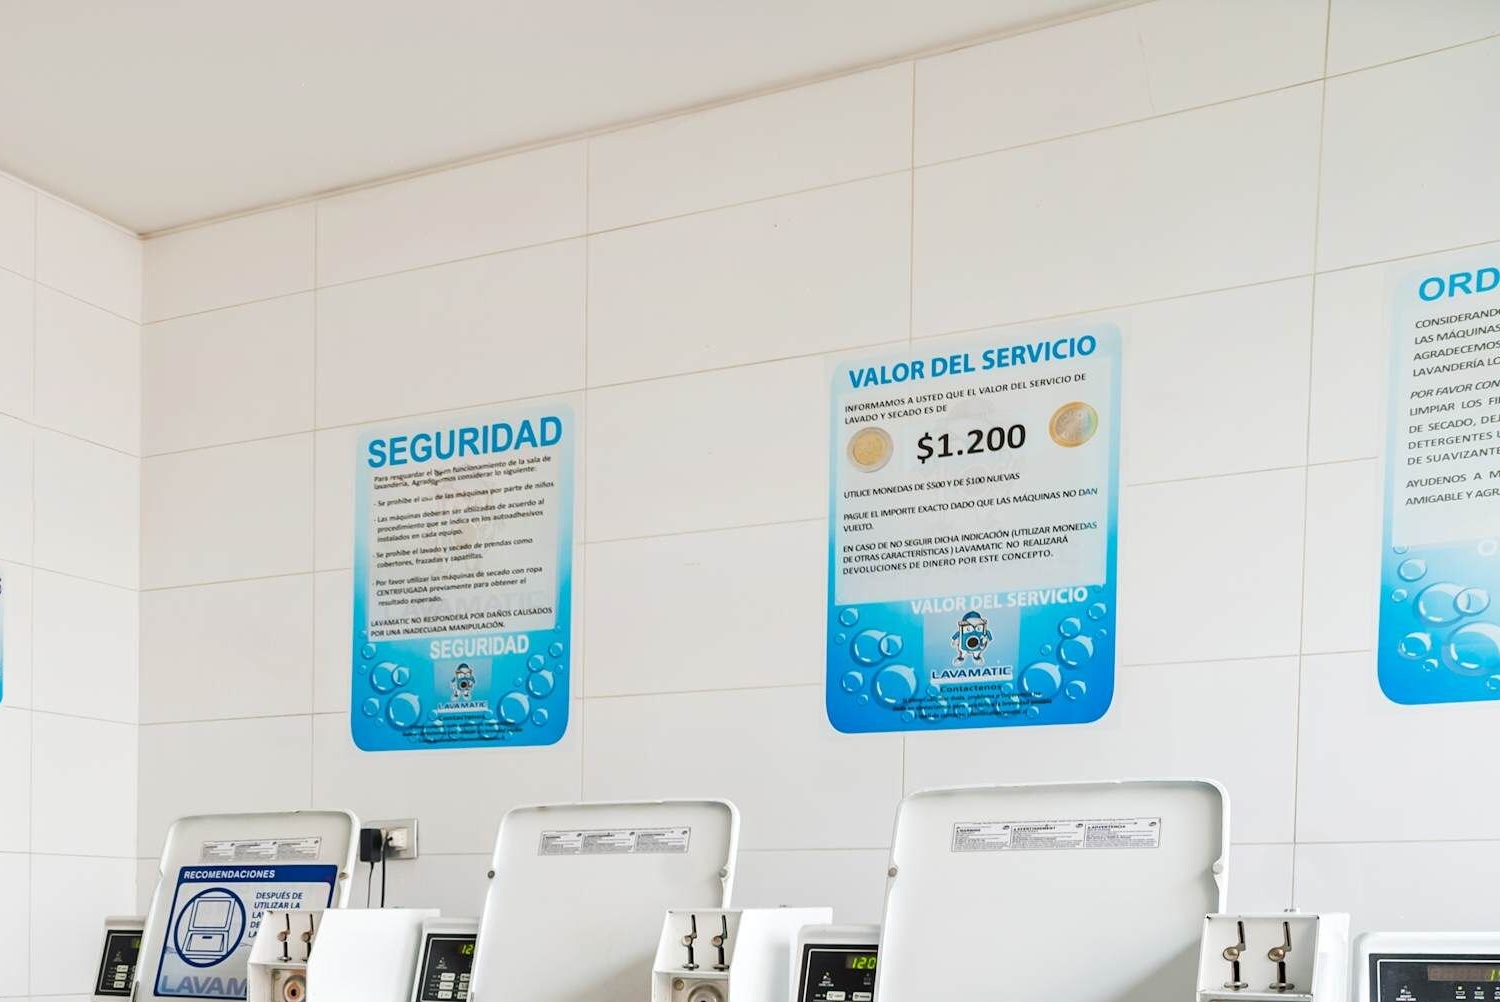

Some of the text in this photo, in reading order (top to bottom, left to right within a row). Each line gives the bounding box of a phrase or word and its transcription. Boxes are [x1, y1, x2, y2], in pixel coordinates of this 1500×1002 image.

[1415, 307, 1500, 329] CONSIDERAND
[1414, 333, 1433, 345] LAS
[1413, 339, 1500, 361] AGRADECEMOS
[848, 333, 1097, 388] VALOR DEL SERVICIO
[1413, 357, 1484, 377] LAVANDERÍA
[845, 372, 1086, 413] INFORMAMOS A USTED QUE EL VALOR DEL SERVICIO DE
[1410, 388, 1432, 399] POR
[1435, 383, 1471, 396] FAVOR
[845, 403, 947, 424] LAVADO Y SECADO ES DE
[1409, 402, 1454, 416] LIMPIAR
[1461, 398, 1481, 409] LOS
[1409, 424, 1422, 434] DE
[1428, 417, 1475, 432] SECADO,
[367, 415, 562, 468] SEGURIDAD
[916, 420, 1025, 464] $1.200
[1408, 431, 1492, 450] DETERGENTES
[1407, 456, 1422, 466] DE
[843, 472, 1019, 498] UTILICE MONEDAS DE $500 Y DE $100 NUEVAS
[1406, 474, 1466, 488] AYUDENOS
[1473, 472, 1481, 480] A
[843, 487, 1097, 520] PAGUE EL IMPORTE EXACTO DADO QUE LAS MÁQUINAS NO DAN
[1405, 491, 1461, 506] AMIGABLE
[1466, 490, 1473, 499] Y
[843, 522, 873, 532] VUELTO.
[843, 521, 1096, 552] EN CASO DE NO SEGUIR DICHA INDICACIÓN (UTILIZAR MONEDAS
[843, 554, 852, 563] DE
[854, 551, 879, 562] OTRAS
[955, 541, 1002, 553] LAVAMATIC
[1006, 539, 1019, 549] NO
[1023, 535, 1067, 548] REALIZARÁ
[843, 549, 1053, 575] DEVOLUCIONES DE DINERO POR ESTE CONCEPTO.
[441, 572, 473, 581] máquinas
[486, 568, 509, 576] secado
[376, 585, 427, 596] CENTRIFUGADA
[429, 581, 472, 592] previamente
[491, 577, 517, 586] obtener
[378, 594, 442, 606] resultado esperado.
[911, 586, 1087, 615] VALOR DEL SERVICIO
[371, 617, 409, 627] LAVAMATIC
[423, 612, 468, 622] RESPONDERÁ
[470, 611, 484, 619] POR
[487, 608, 511, 618] DAÑOS
[513, 606, 552, 615] CAUSADOS
[402, 625, 446, 635] INADECUADA
[449, 620, 504, 631] MANIPULACIÓN.
[429, 634, 529, 660] SEGURIDAD
[932, 666, 1011, 679] LAVAMATIC
[184, 870, 276, 879] RECOMENDACIONES
[256, 891, 290, 899] DESPUÉS
[462, 944, 474, 955] 12
[852, 956, 876, 969] 120
